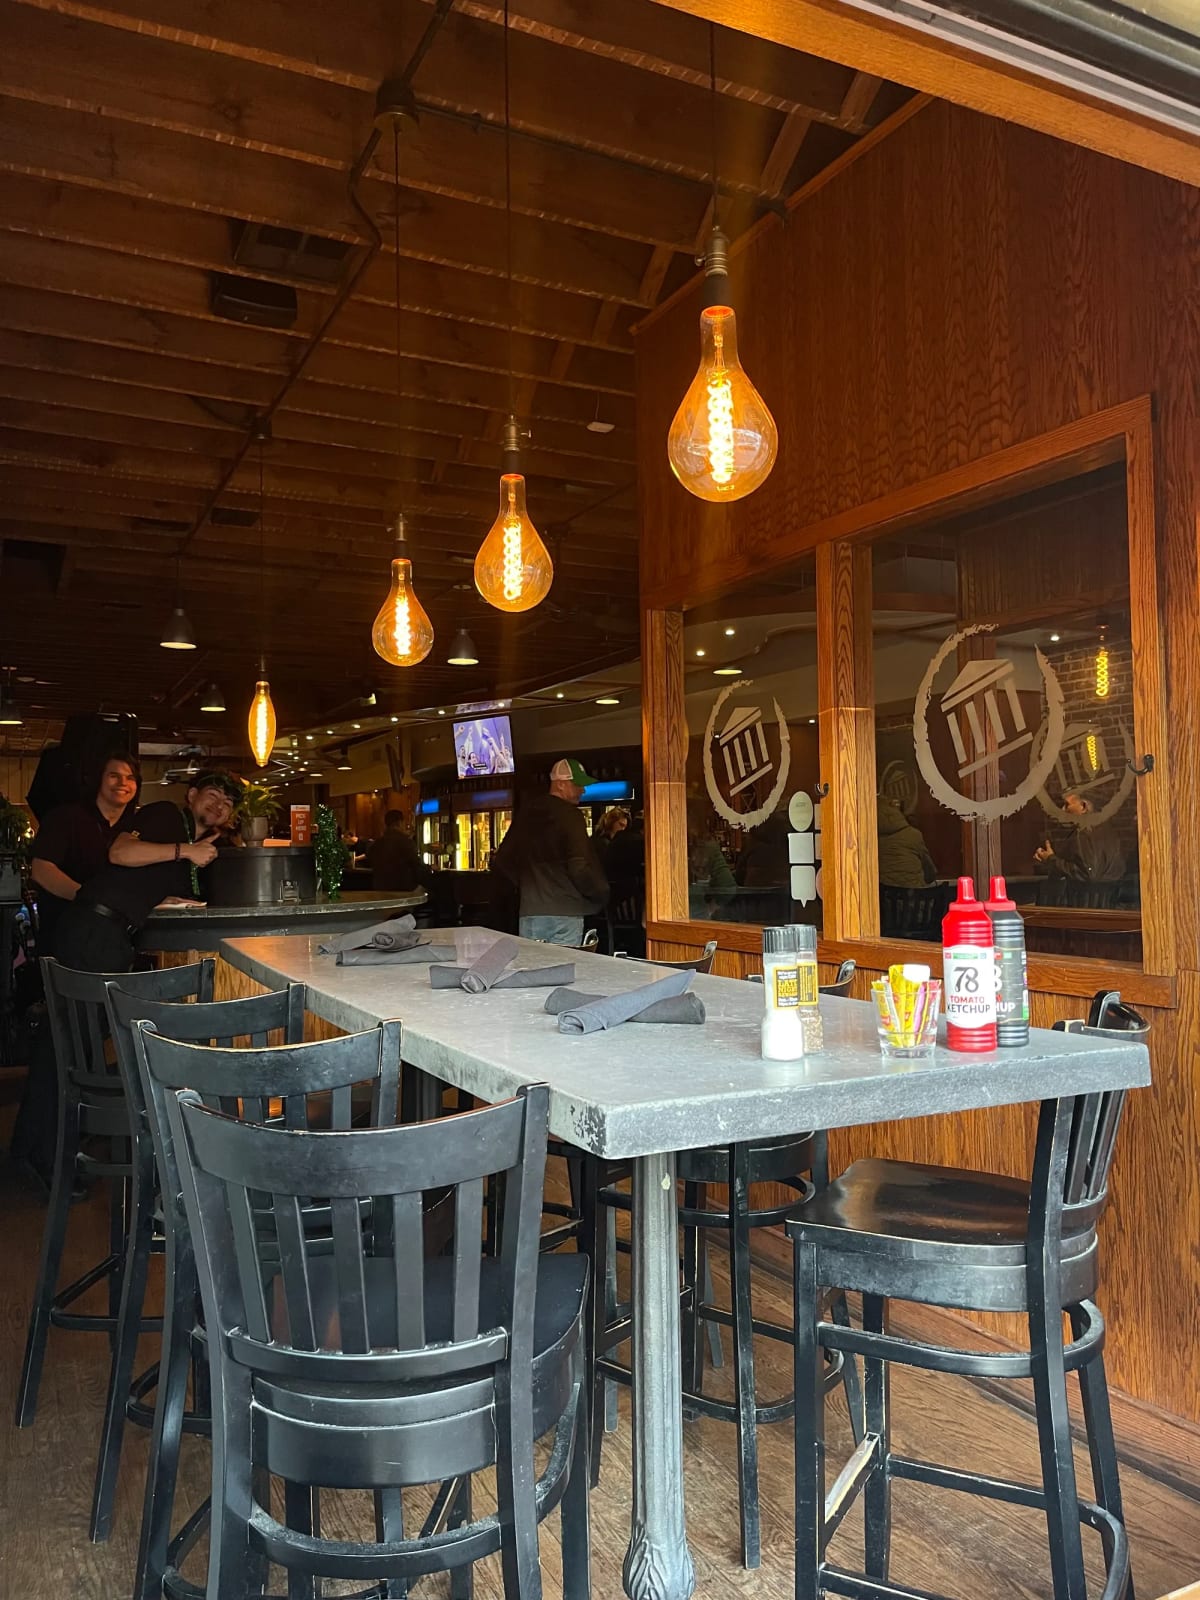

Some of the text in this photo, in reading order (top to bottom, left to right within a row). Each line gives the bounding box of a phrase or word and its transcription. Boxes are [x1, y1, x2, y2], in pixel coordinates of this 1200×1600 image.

[953, 966, 979, 993] 78
[950, 995, 984, 1003] TOMATO
[948, 1004, 990, 1013] KETCHUP
